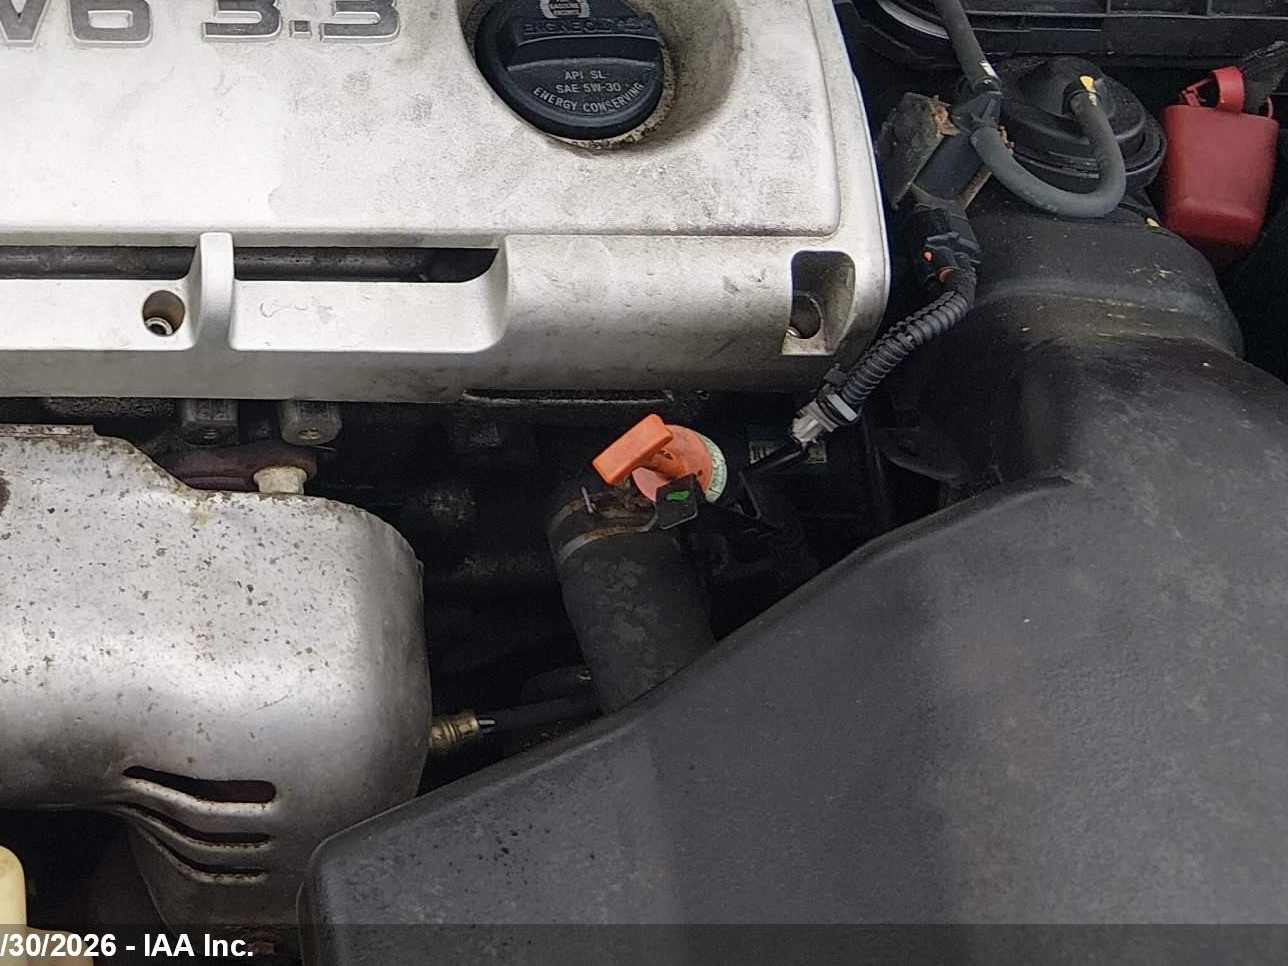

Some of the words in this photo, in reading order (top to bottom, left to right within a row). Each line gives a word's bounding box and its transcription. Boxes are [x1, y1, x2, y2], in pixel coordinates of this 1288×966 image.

[564, 71, 584, 81] API
[590, 70, 607, 80] SL
[555, 84, 579, 94] SAE
[583, 82, 622, 94] 5W-30
[533, 86, 578, 112] ENERGY
[582, 82, 645, 114] CONSERVING
